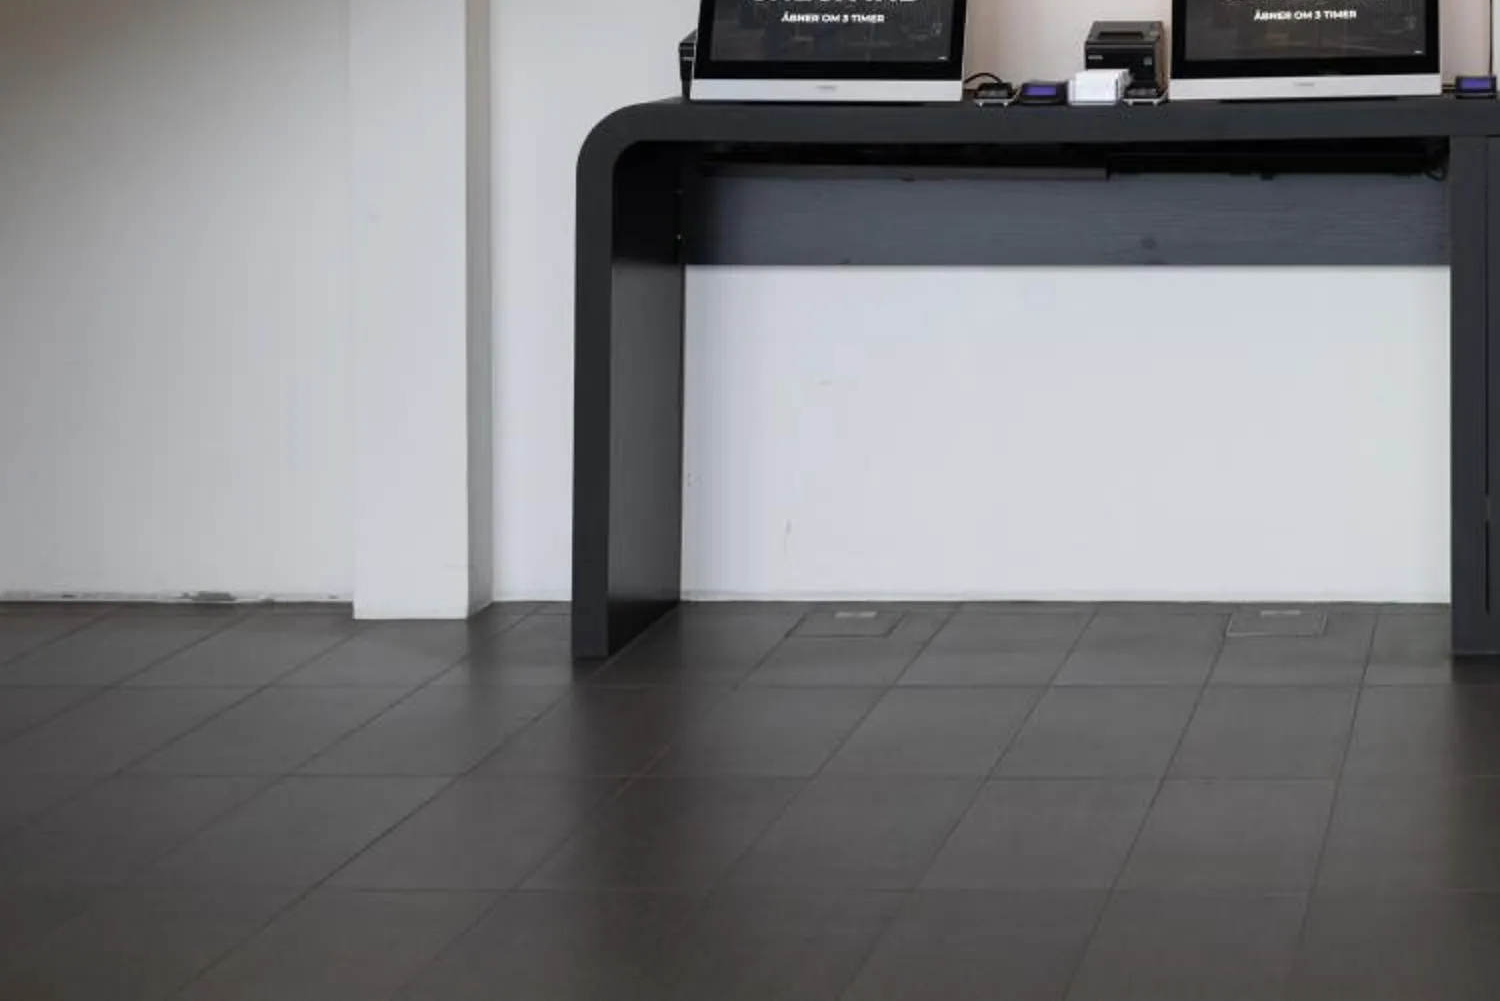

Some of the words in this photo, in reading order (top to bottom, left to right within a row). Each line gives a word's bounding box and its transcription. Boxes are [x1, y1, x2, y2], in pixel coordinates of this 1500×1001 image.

[821, 13, 841, 23] OM
[851, 13, 885, 24] TIMER
[1293, 10, 1313, 20] OM
[1323, 9, 1357, 20] TIMER
